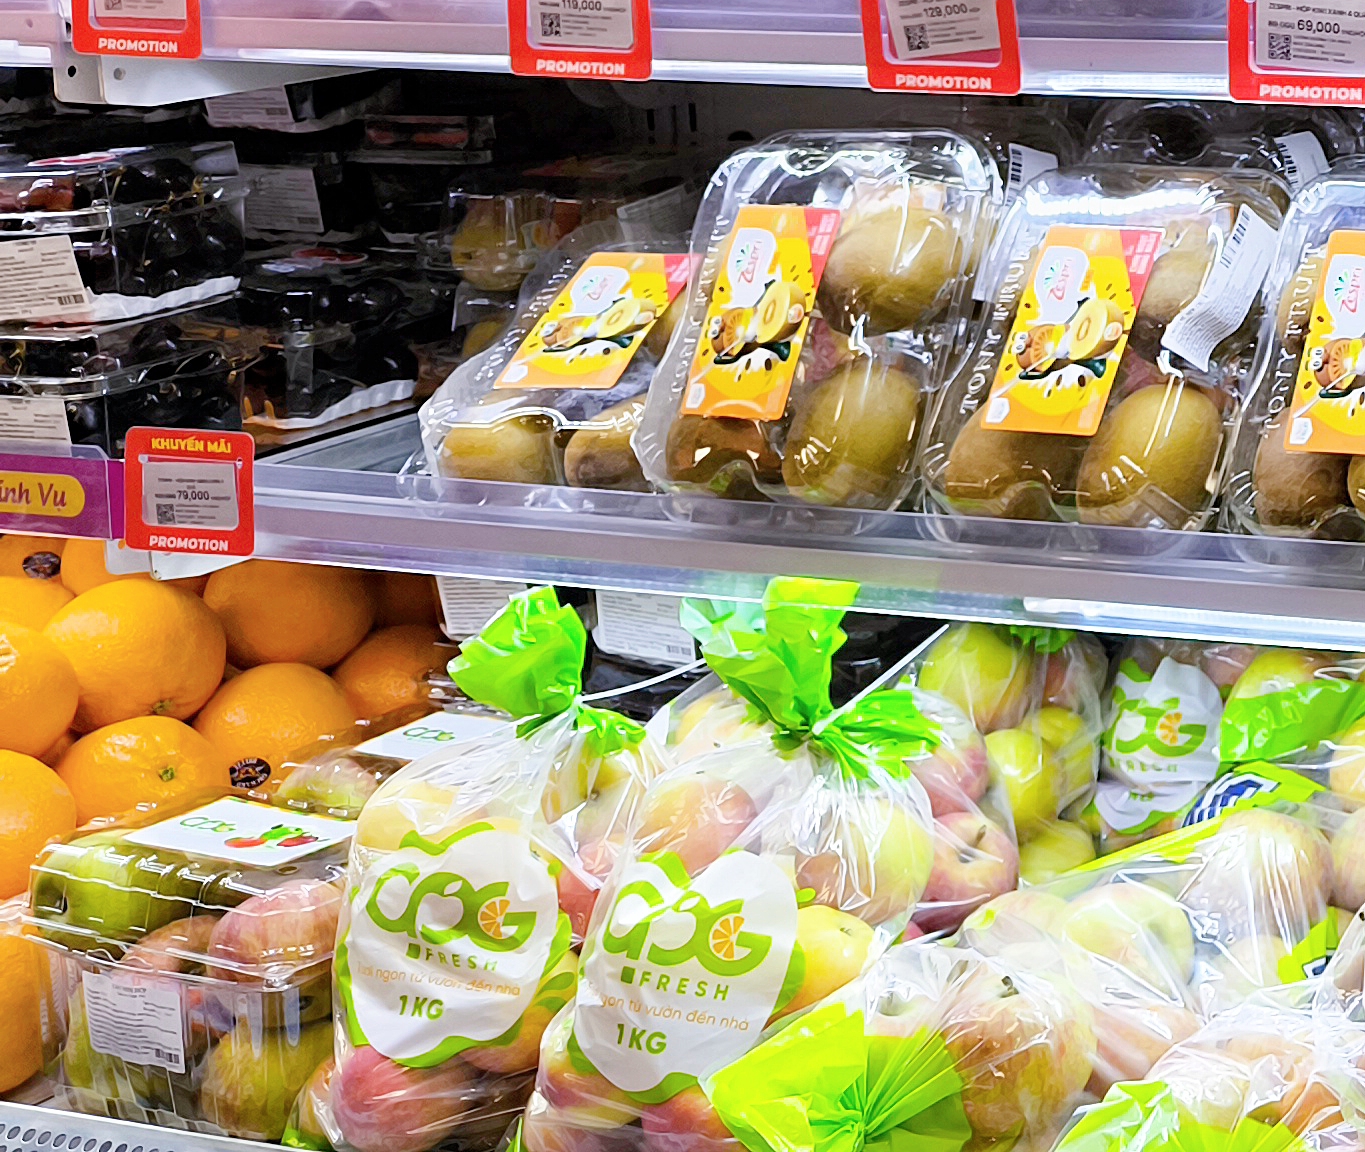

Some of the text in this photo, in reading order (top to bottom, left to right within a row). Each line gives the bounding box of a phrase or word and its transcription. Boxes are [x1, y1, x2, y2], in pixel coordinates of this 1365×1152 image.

[561, 0, 602, 12] 119,000
[1297, 19, 1340, 34] 69,000
[98, 37, 178, 53] PROMOTION
[536, 59, 625, 75] PROMOTION
[895, 74, 992, 89] PROMOTION
[1260, 84, 1362, 101] PROMOTION
[152, 436, 231, 453] KHUYẾN MÃI
[38, 483, 67, 511] Vụ
[177, 491, 209, 501] 79,000
[149, 535, 229, 552] PROMOTION
[425, 948, 497, 971] FRESH
[639, 971, 729, 1001] FRESH
[686, 1010, 749, 1031] đến nhà
